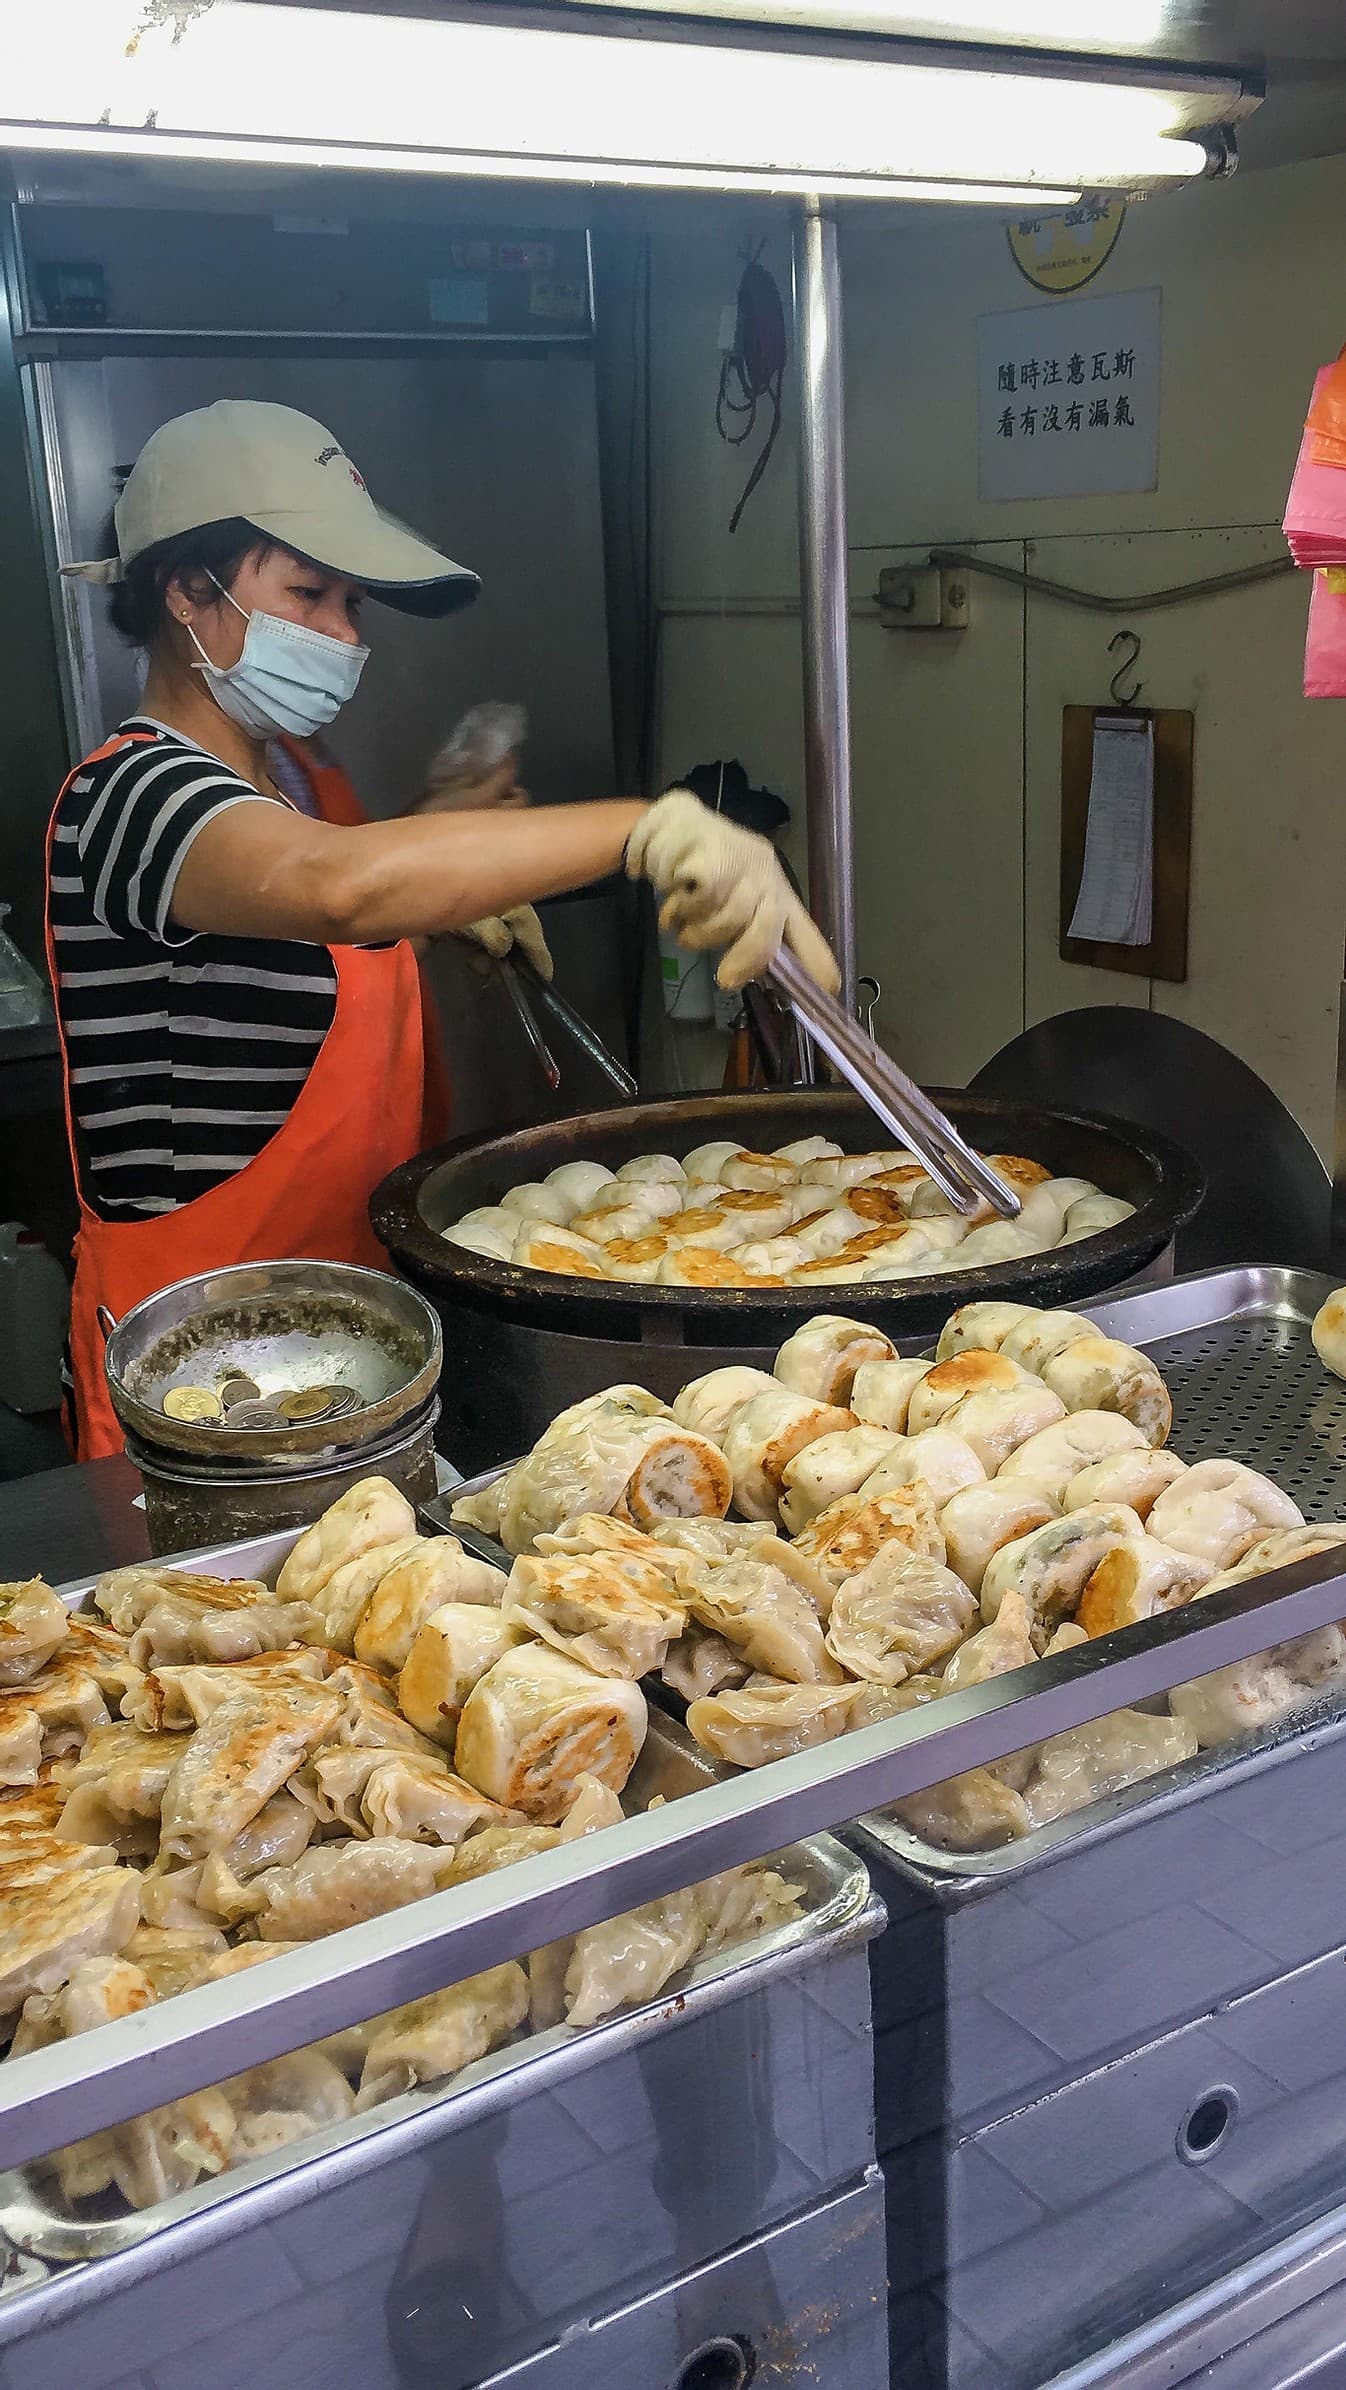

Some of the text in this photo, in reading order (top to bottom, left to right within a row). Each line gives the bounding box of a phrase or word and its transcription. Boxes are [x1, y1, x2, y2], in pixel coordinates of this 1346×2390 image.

[997, 348, 1136, 393] 隨時注意瓦斯
[997, 395, 1135, 438] 看有沒有漏氣
